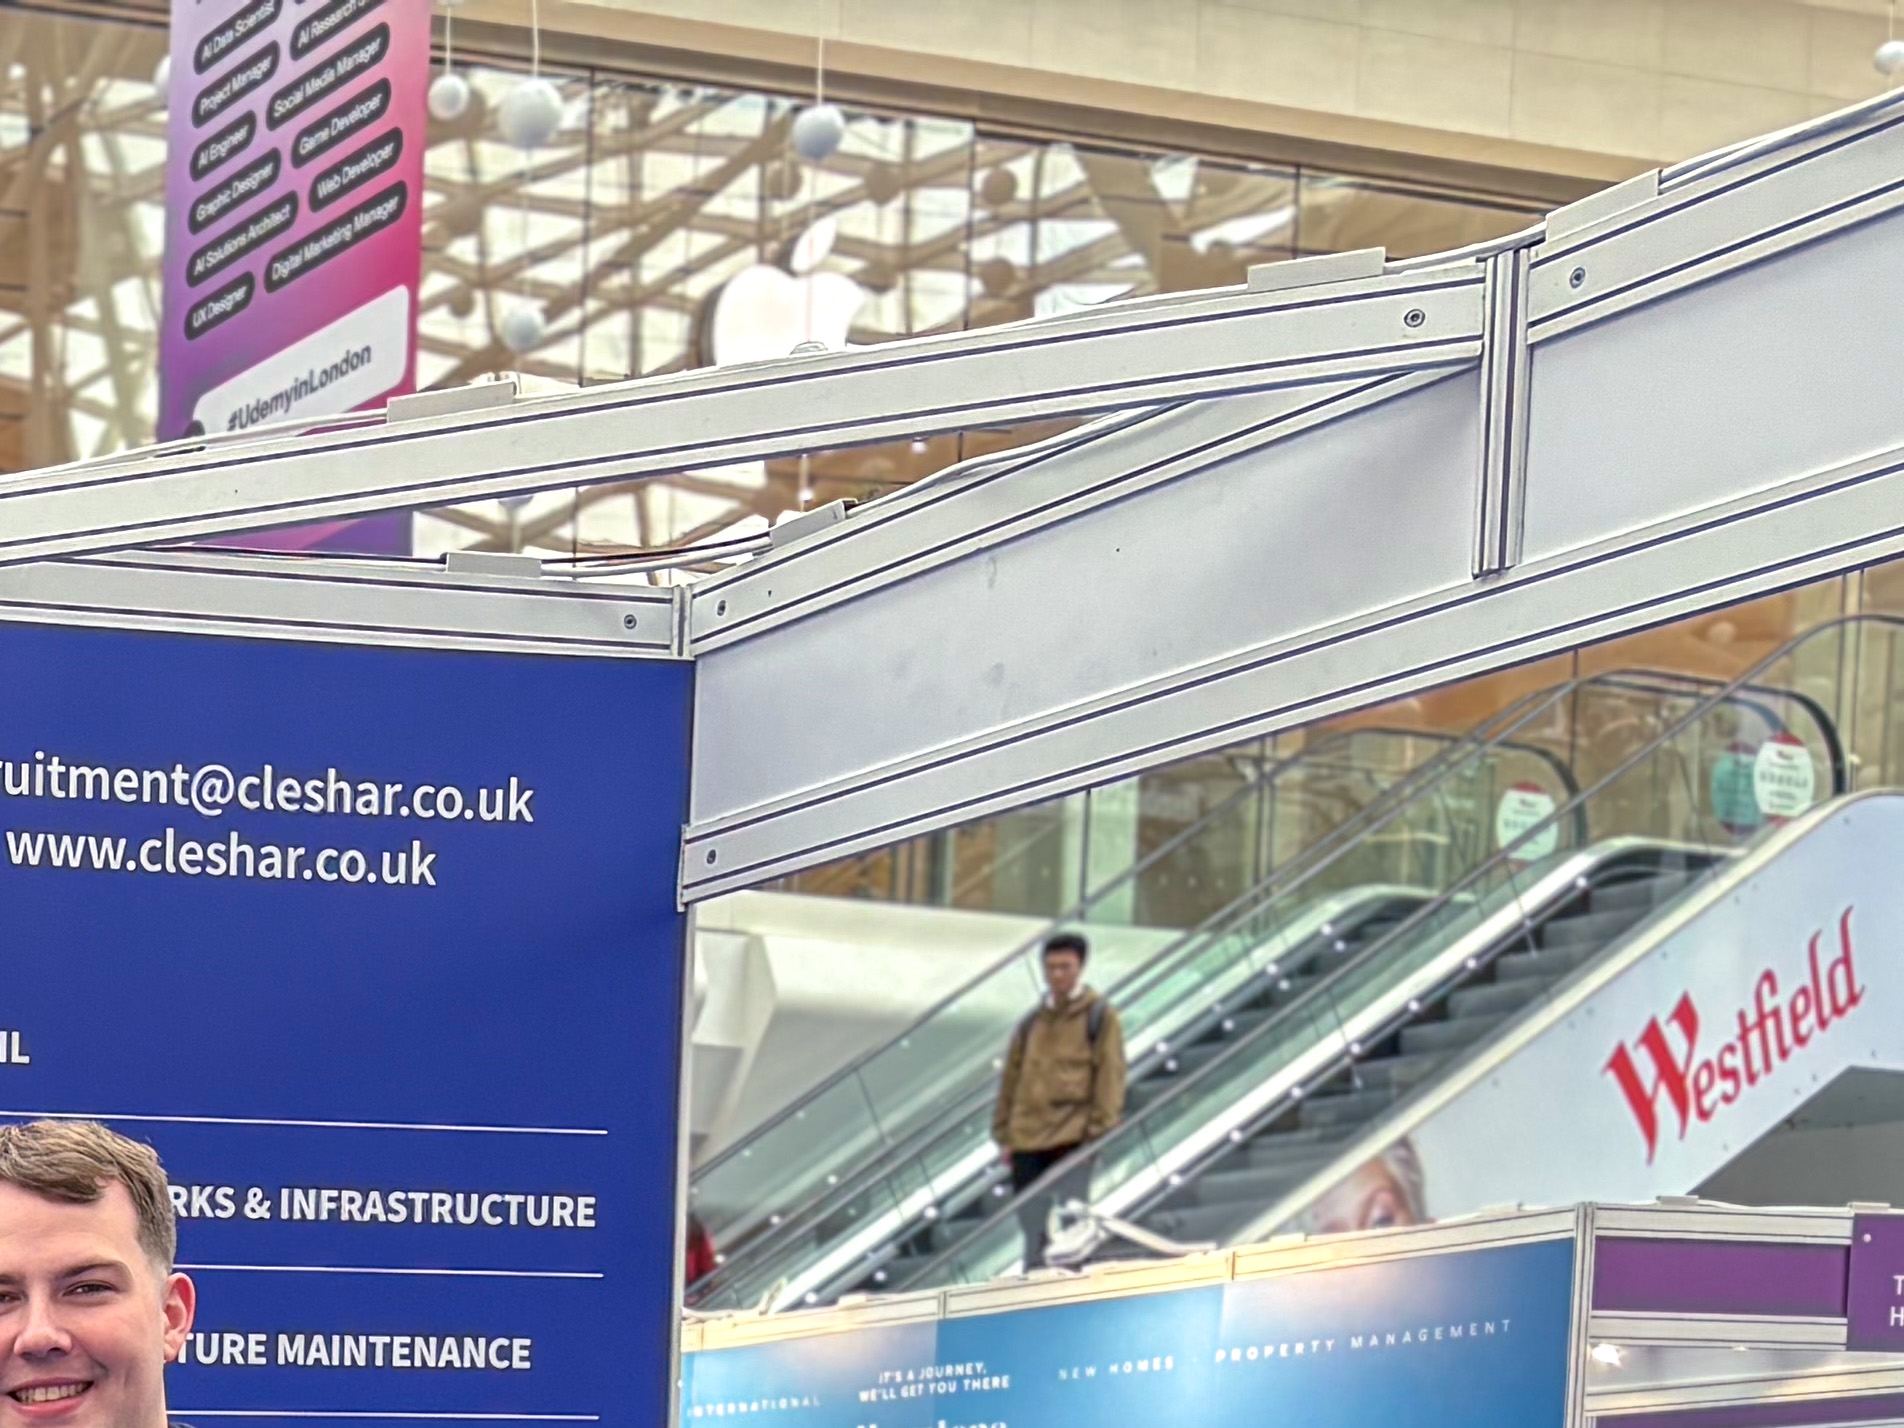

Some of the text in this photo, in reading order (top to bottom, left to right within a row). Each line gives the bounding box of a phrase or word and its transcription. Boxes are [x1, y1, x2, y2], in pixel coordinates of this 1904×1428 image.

[232, 56, 272, 92] Manager
[273, 38, 381, 117] Social Media Manager
[210, 126, 249, 161] Engineer
[300, 93, 382, 155] Game Developer
[196, 163, 274, 221] Graphic Designer
[317, 143, 394, 198] Web Developer
[207, 231, 248, 267] Solutions
[247, 204, 290, 239] Architect
[271, 196, 399, 280] Digital Marketing Manager
[193, 286, 247, 327] UX Designer
[227, 343, 372, 433] #UdemyinLondon
[6, 828, 436, 886] www.cleshar.co.uk
[1601, 904, 1865, 1166] Westfield
[168, 1185, 596, 1228] RKS & INFRASTRUCTURE
[276, 1333, 531, 1370] MAINTENANCE
[879, 1371, 902, 1384] IT'S
[907, 1369, 914, 1381] A
[1058, 1319, 1511, 1380] NEW HOMES PROPERTY MANAGEMENT
[859, 1375, 1010, 1403] WE'LL GET YOU THERE
